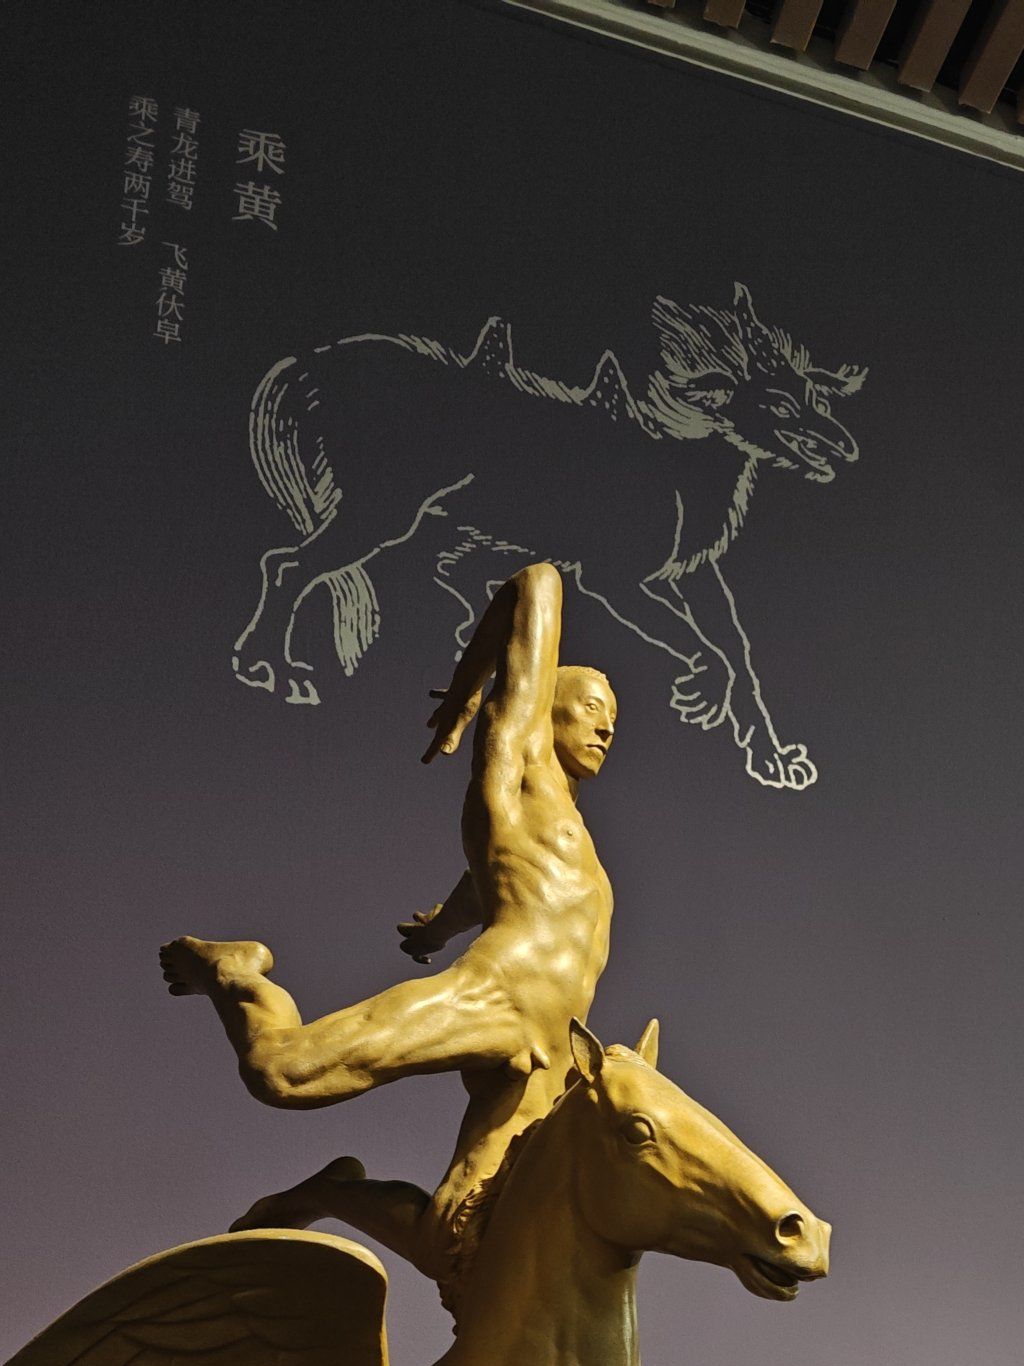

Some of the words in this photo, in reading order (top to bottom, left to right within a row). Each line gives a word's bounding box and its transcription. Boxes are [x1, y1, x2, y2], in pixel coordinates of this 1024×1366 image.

[117, 95, 160, 247] 乘之寿两千岁
[165, 107, 200, 211] 青龙进驾
[231, 128, 287, 232] 乘黄
